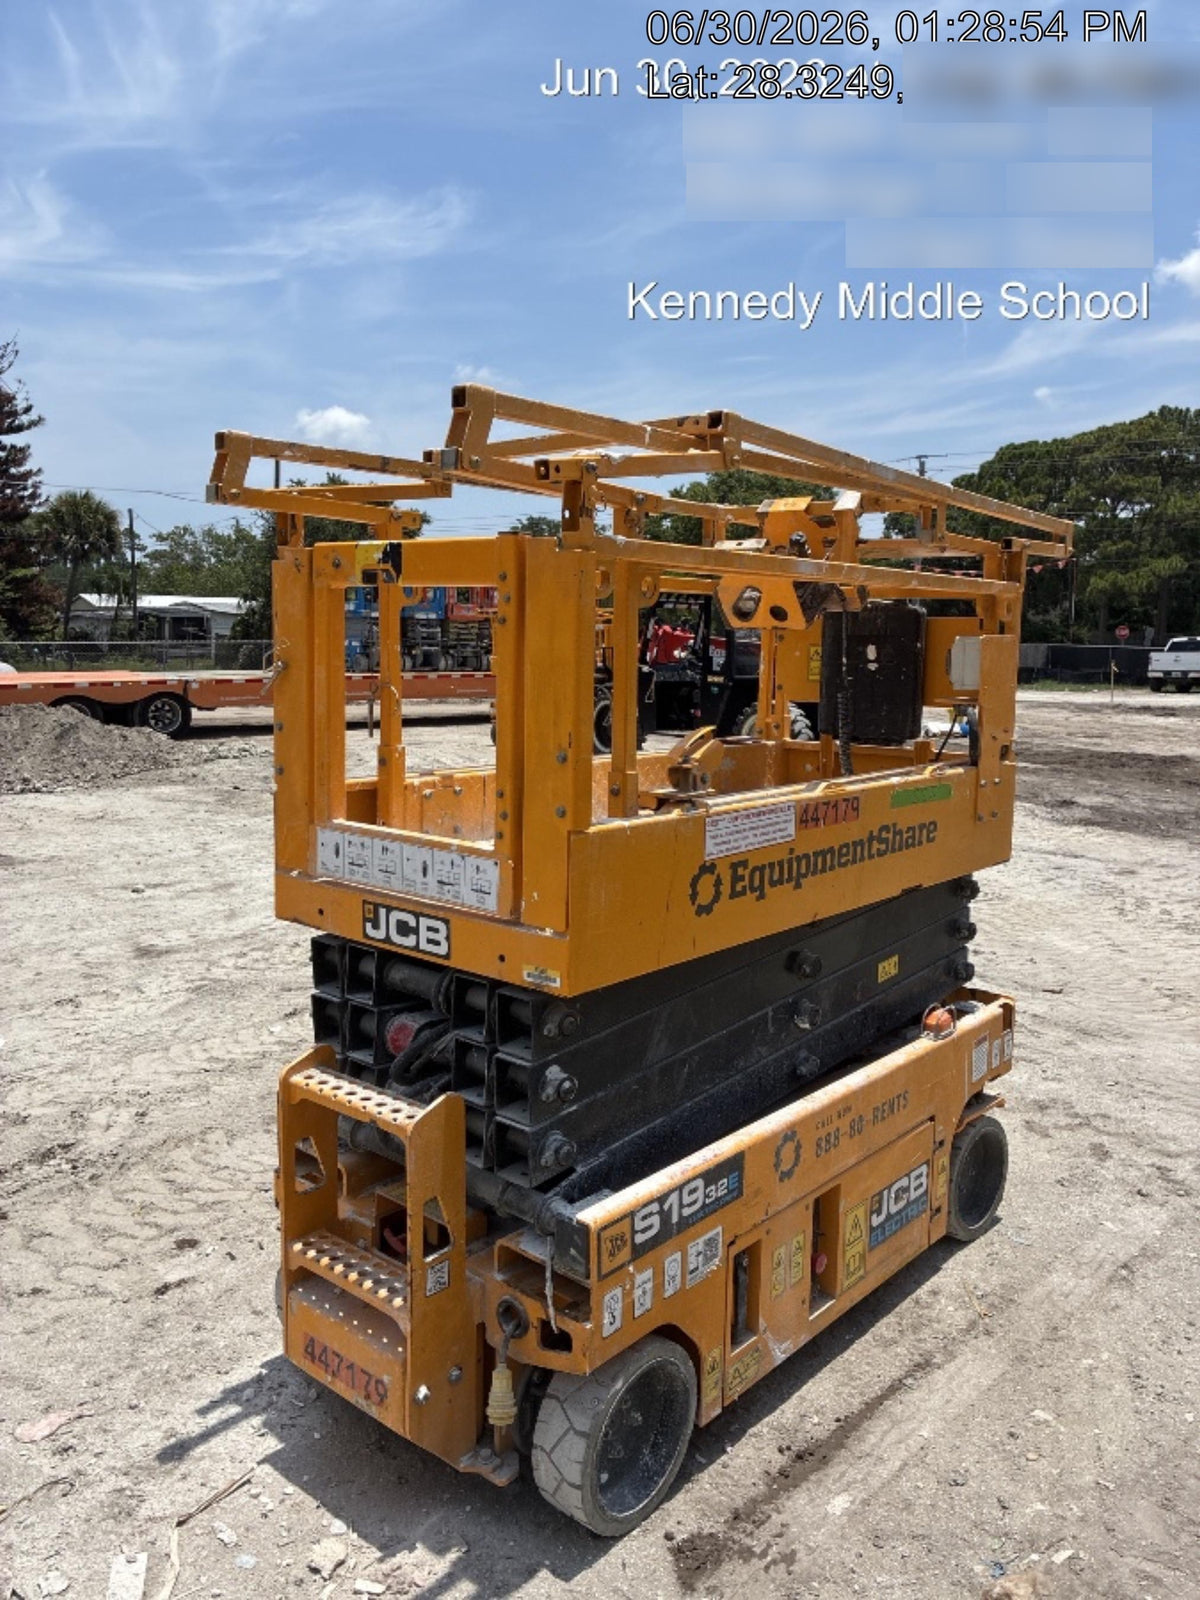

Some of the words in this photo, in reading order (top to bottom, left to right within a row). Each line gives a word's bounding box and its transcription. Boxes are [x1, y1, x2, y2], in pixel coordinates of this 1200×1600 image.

[800, 796, 860, 829] 447179
[729, 820, 938, 901] EquipmentShare
[365, 906, 449, 956] JCB
[871, 1164, 928, 1228] JCB
[303, 1336, 389, 1406] 447179
